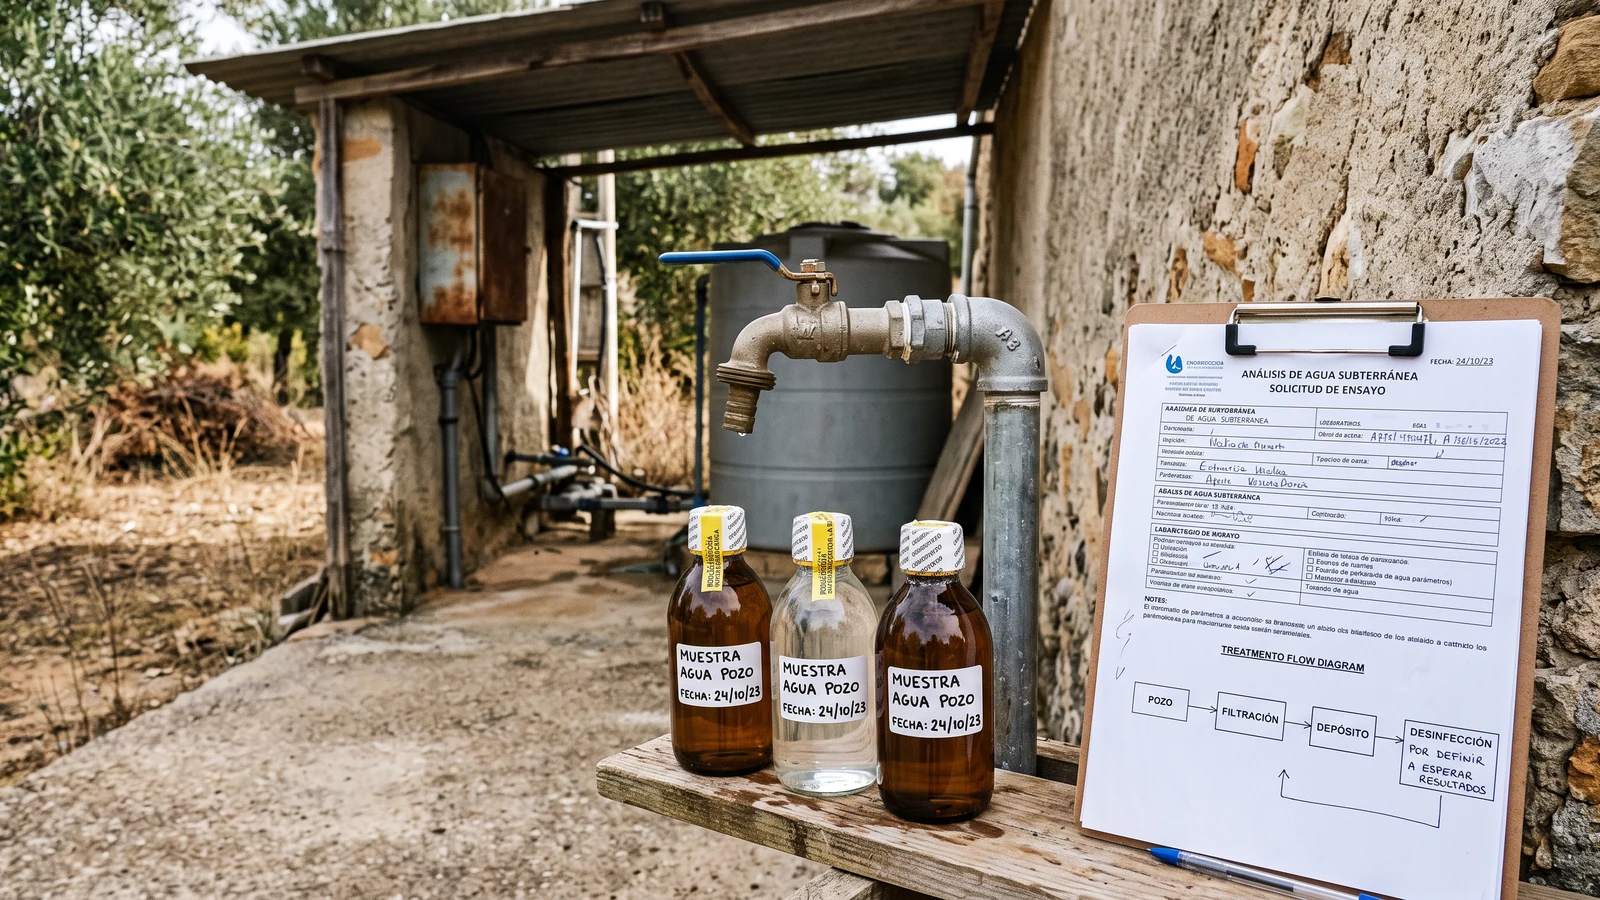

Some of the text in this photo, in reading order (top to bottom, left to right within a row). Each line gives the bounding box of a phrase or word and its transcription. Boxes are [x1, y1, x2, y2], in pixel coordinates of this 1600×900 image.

[1456, 358, 1494, 366] 24/10/23
[1242, 368, 1418, 380] ANÁLISIS DE AGUA SUBTERRÁNEA
[1270, 384, 1386, 396] SOLICITUD DE ENSAYO
[1221, 416, 1268, 424] SUBTERRANEA
[1144, 595, 1167, 604] NOTES:
[1190, 610, 1223, 618] parámetros
[680, 649, 741, 663] MUESTRA
[1222, 645, 1365, 672] TREATMENTO FLOW DIAGRAM
[680, 666, 754, 680] AGUA POZO
[783, 662, 846, 677] MUESTRA
[783, 680, 859, 695] AGUA POZO
[893, 673, 960, 689] MUESTRA
[680, 685, 760, 703] FECHA: 24/10/23
[893, 692, 974, 708] AGUA POZO
[1148, 695, 1173, 707] POZO
[783, 700, 866, 719] FECHA: 24/10/23
[1222, 707, 1279, 724] FILTRACIÓN
[892, 713, 981, 734] FECHA: 24/10/23
[1316, 722, 1369, 739] DEPÓSITO
[1410, 728, 1492, 748] DESINFECCIÓN
[1409, 744, 1429, 756] POR
[1408, 762, 1472, 780] A ESPERAR
[1419, 775, 1486, 794] RESULTADOS
